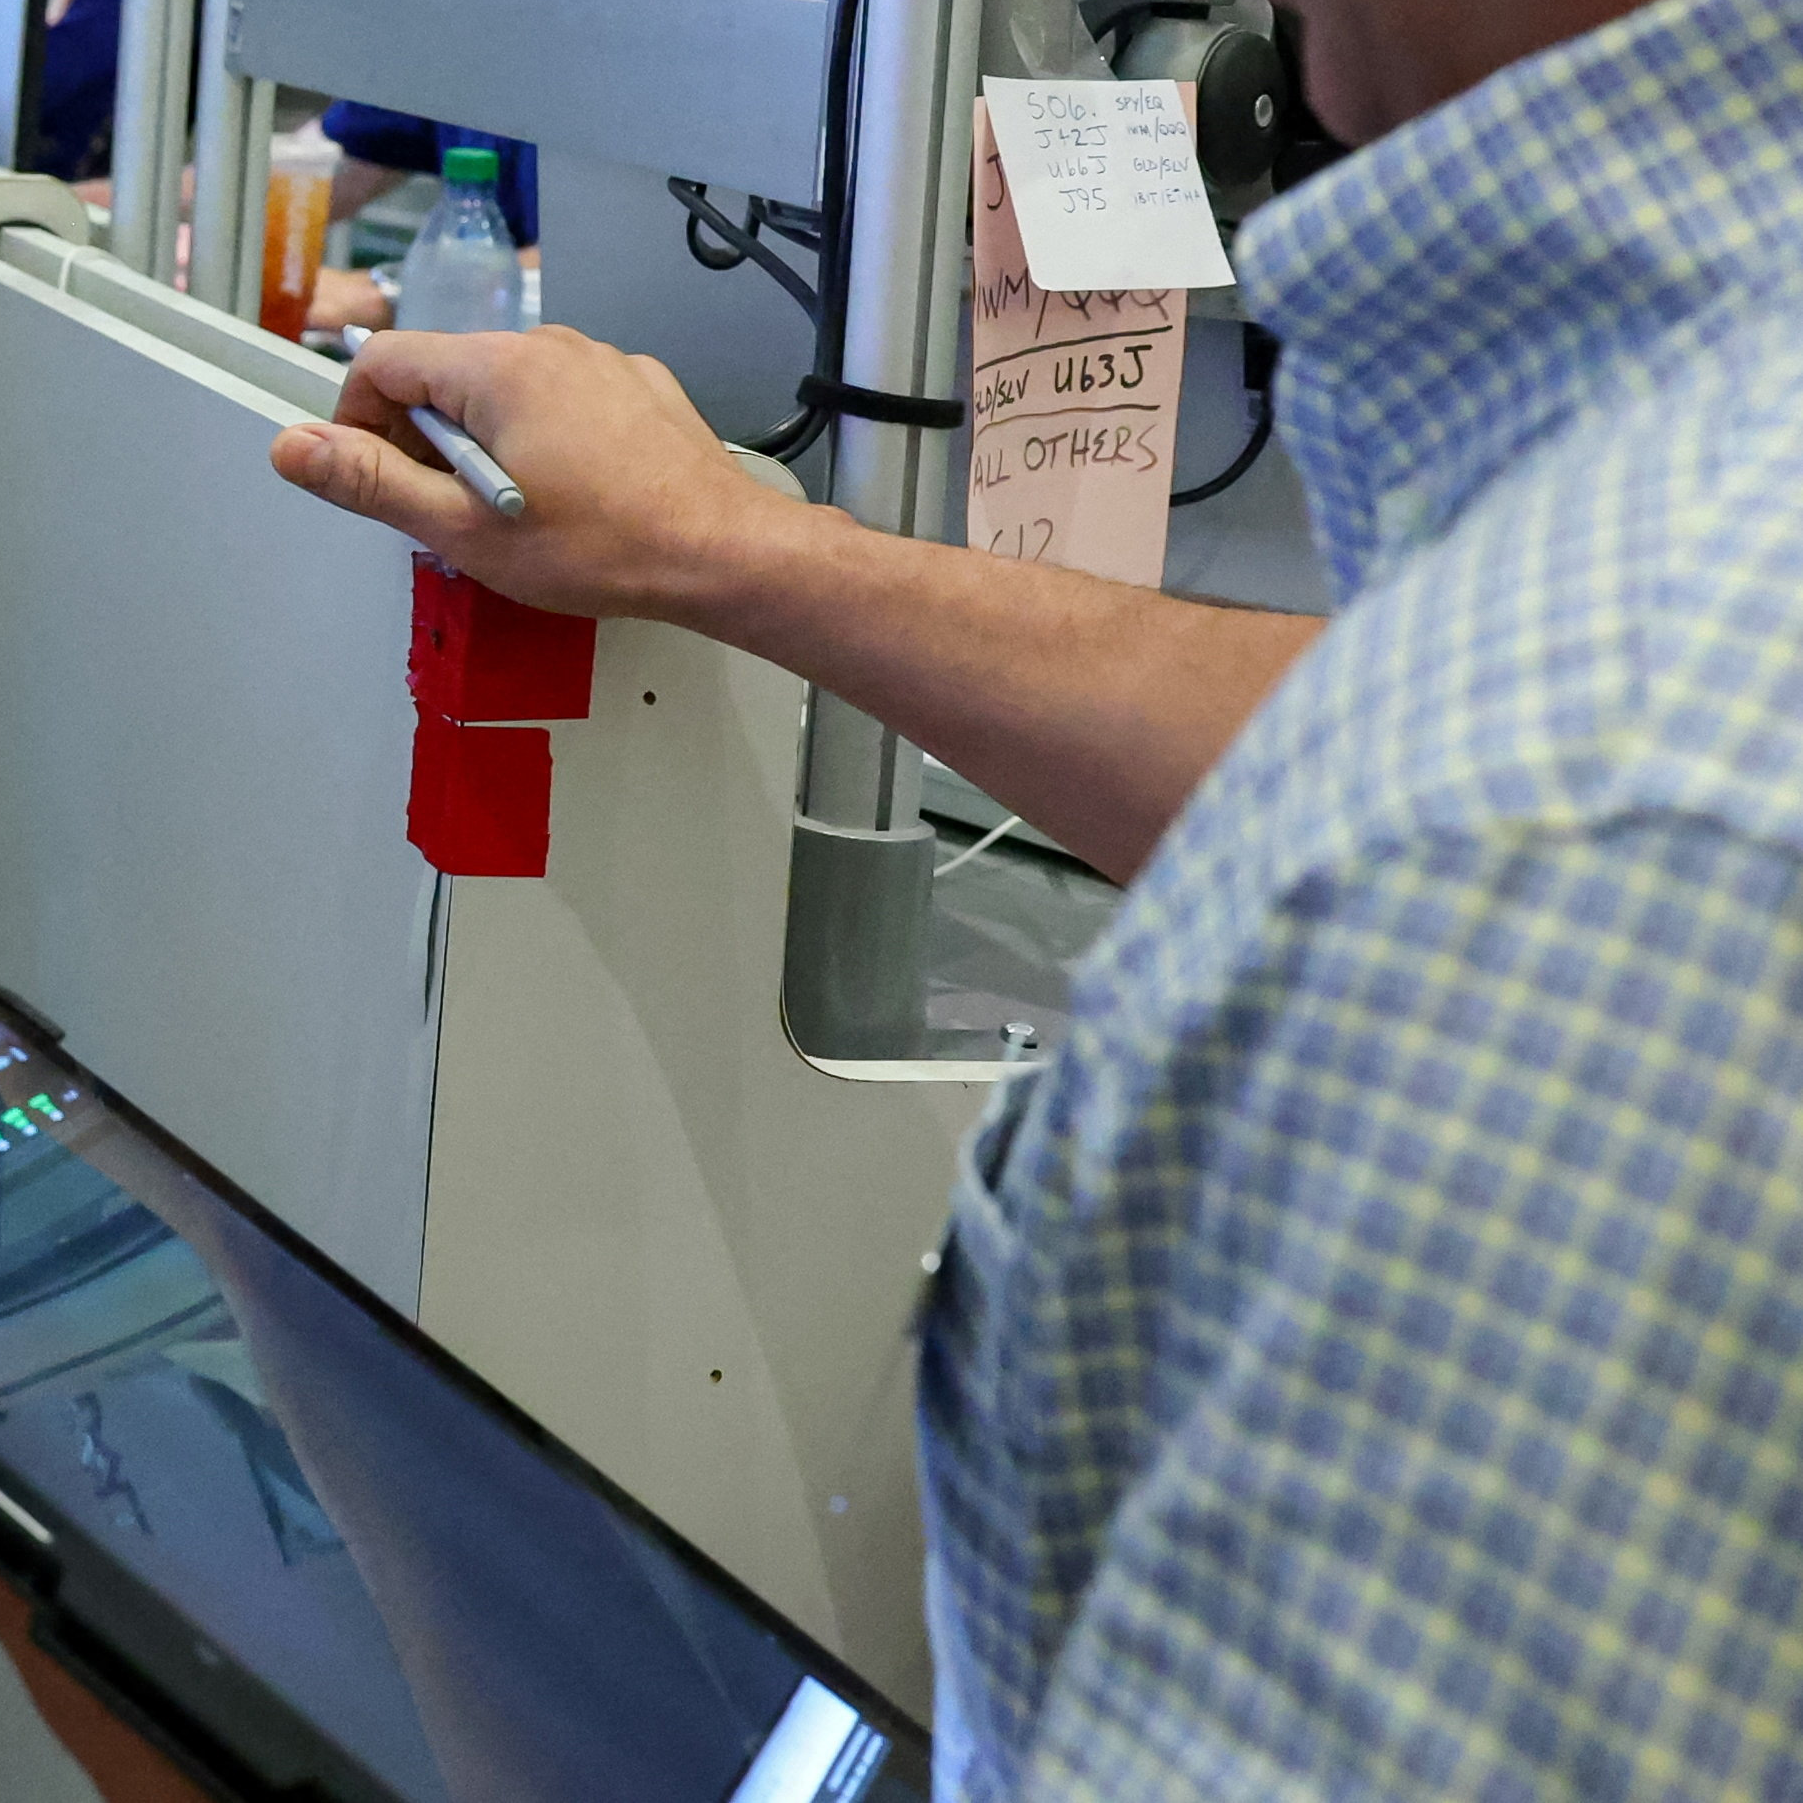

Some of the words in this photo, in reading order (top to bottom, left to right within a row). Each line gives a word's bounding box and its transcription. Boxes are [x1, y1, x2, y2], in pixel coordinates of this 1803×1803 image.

[1058, 187, 1108, 214] J95
[973, 449, 1011, 497] ALL
[1023, 423, 1159, 473] OTHERS
